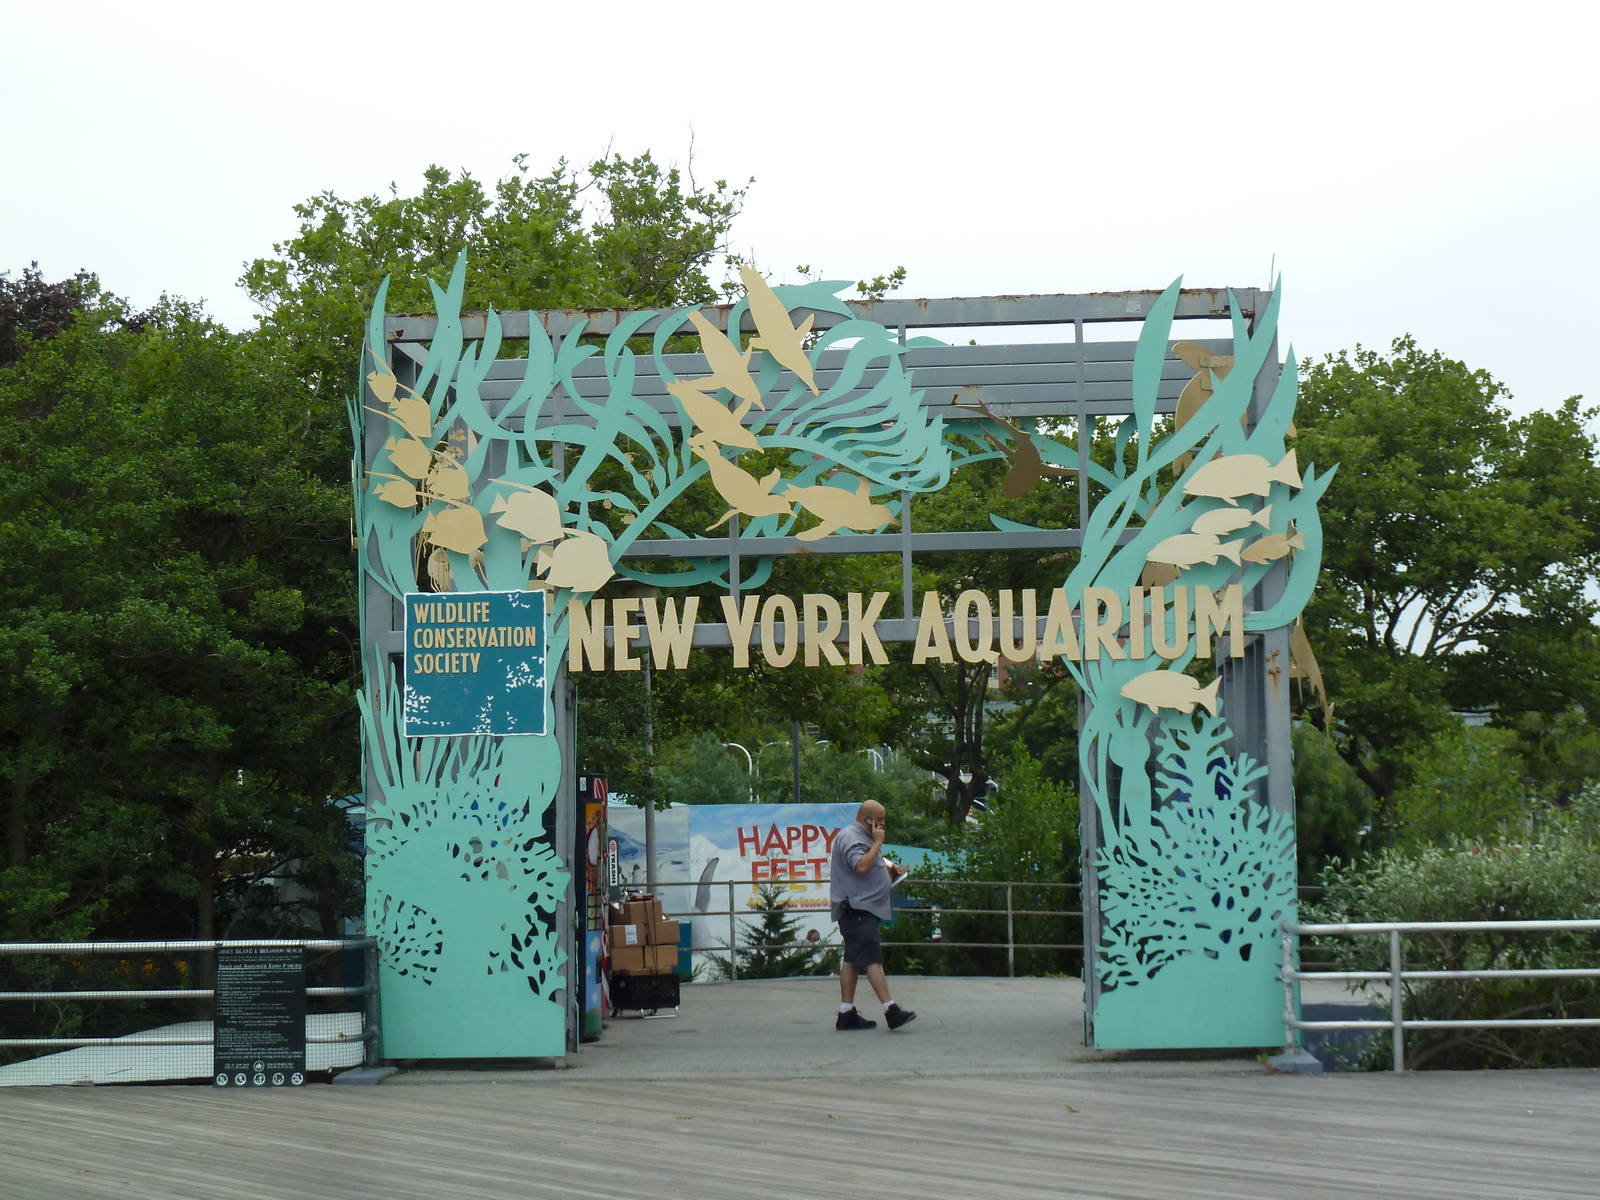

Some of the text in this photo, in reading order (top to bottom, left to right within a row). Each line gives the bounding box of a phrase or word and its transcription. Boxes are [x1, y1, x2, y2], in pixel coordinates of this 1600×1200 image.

[413, 602, 490, 624] WILDLIFE
[413, 626, 536, 649] CONSERVATION
[568, 584, 1245, 672] NEW YORK AQUARIUM
[413, 652, 481, 675] SOCIETY
[737, 822, 841, 857] HAPPY
[751, 858, 829, 894] FEET
